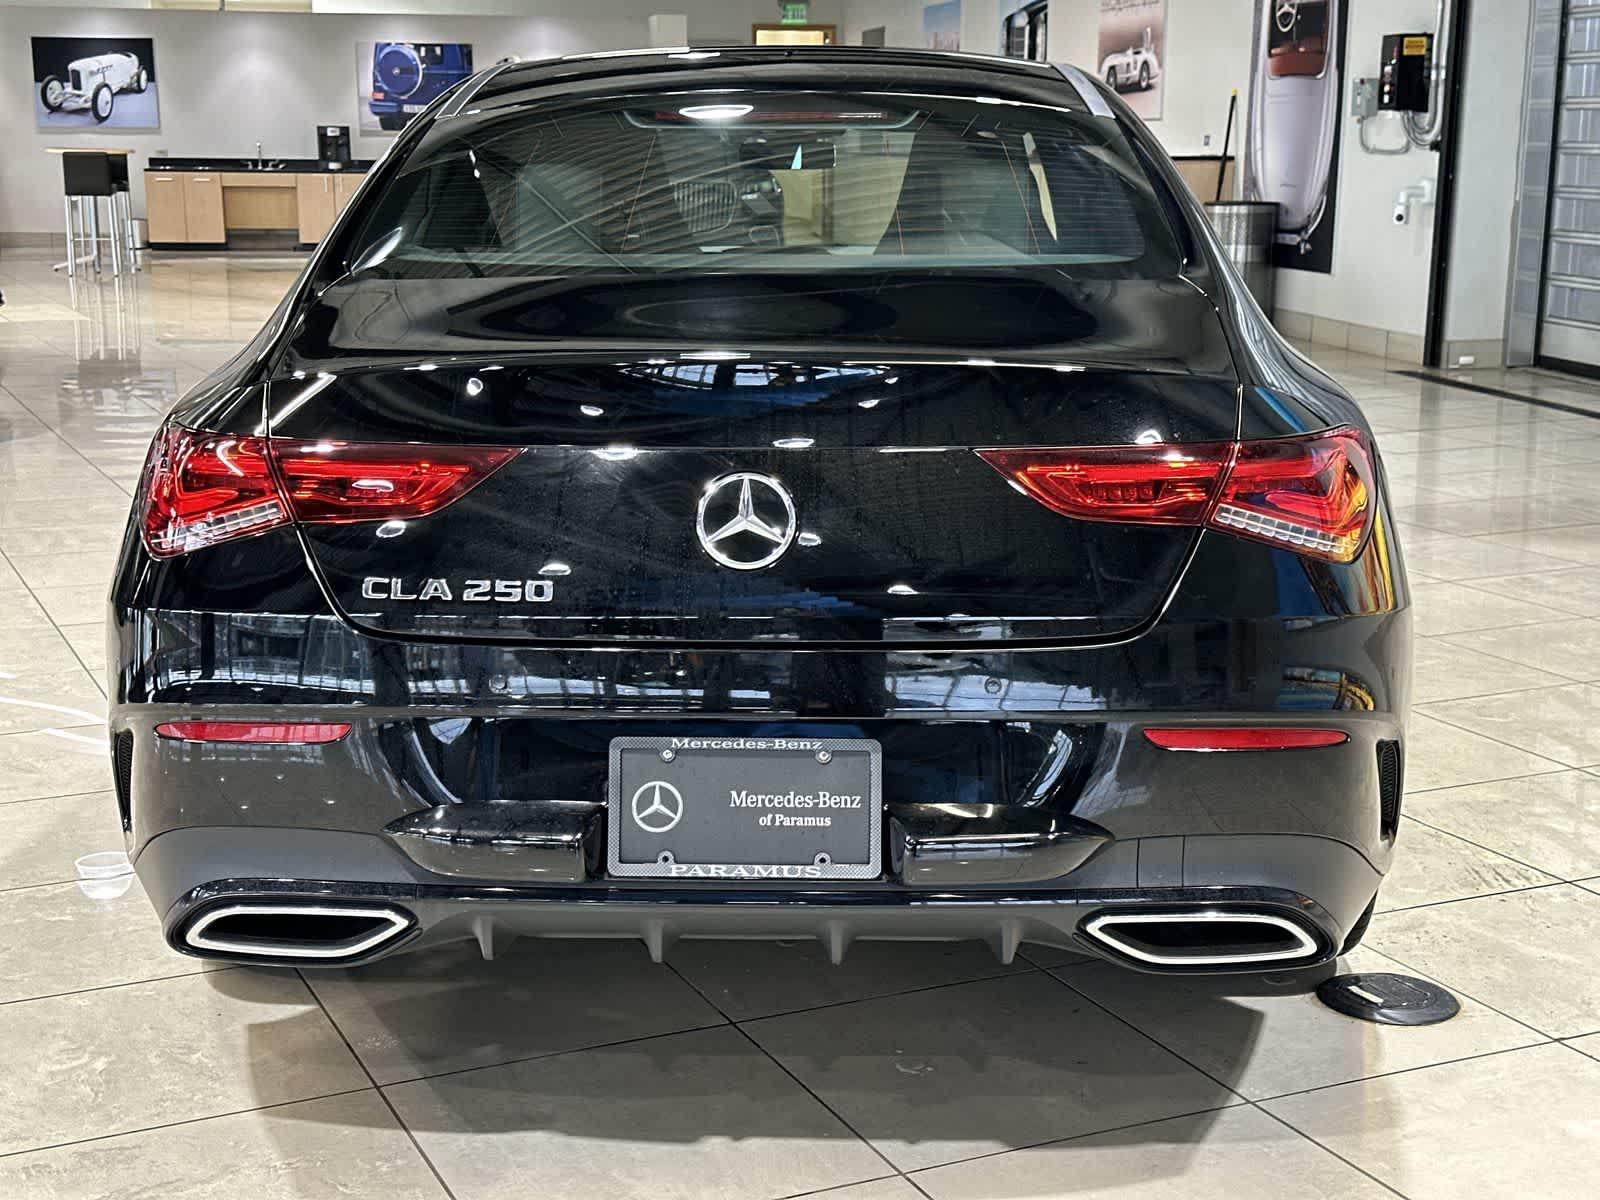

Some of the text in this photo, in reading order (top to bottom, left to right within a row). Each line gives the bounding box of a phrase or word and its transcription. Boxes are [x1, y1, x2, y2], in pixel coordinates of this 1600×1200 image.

[362, 576, 554, 602] CLA 250
[671, 738, 823, 750] Mercedes-Benz
[729, 791, 861, 808] Mercedes-Benz
[759, 814, 831, 827] of Paramus
[671, 865, 821, 878] PARAMUS
